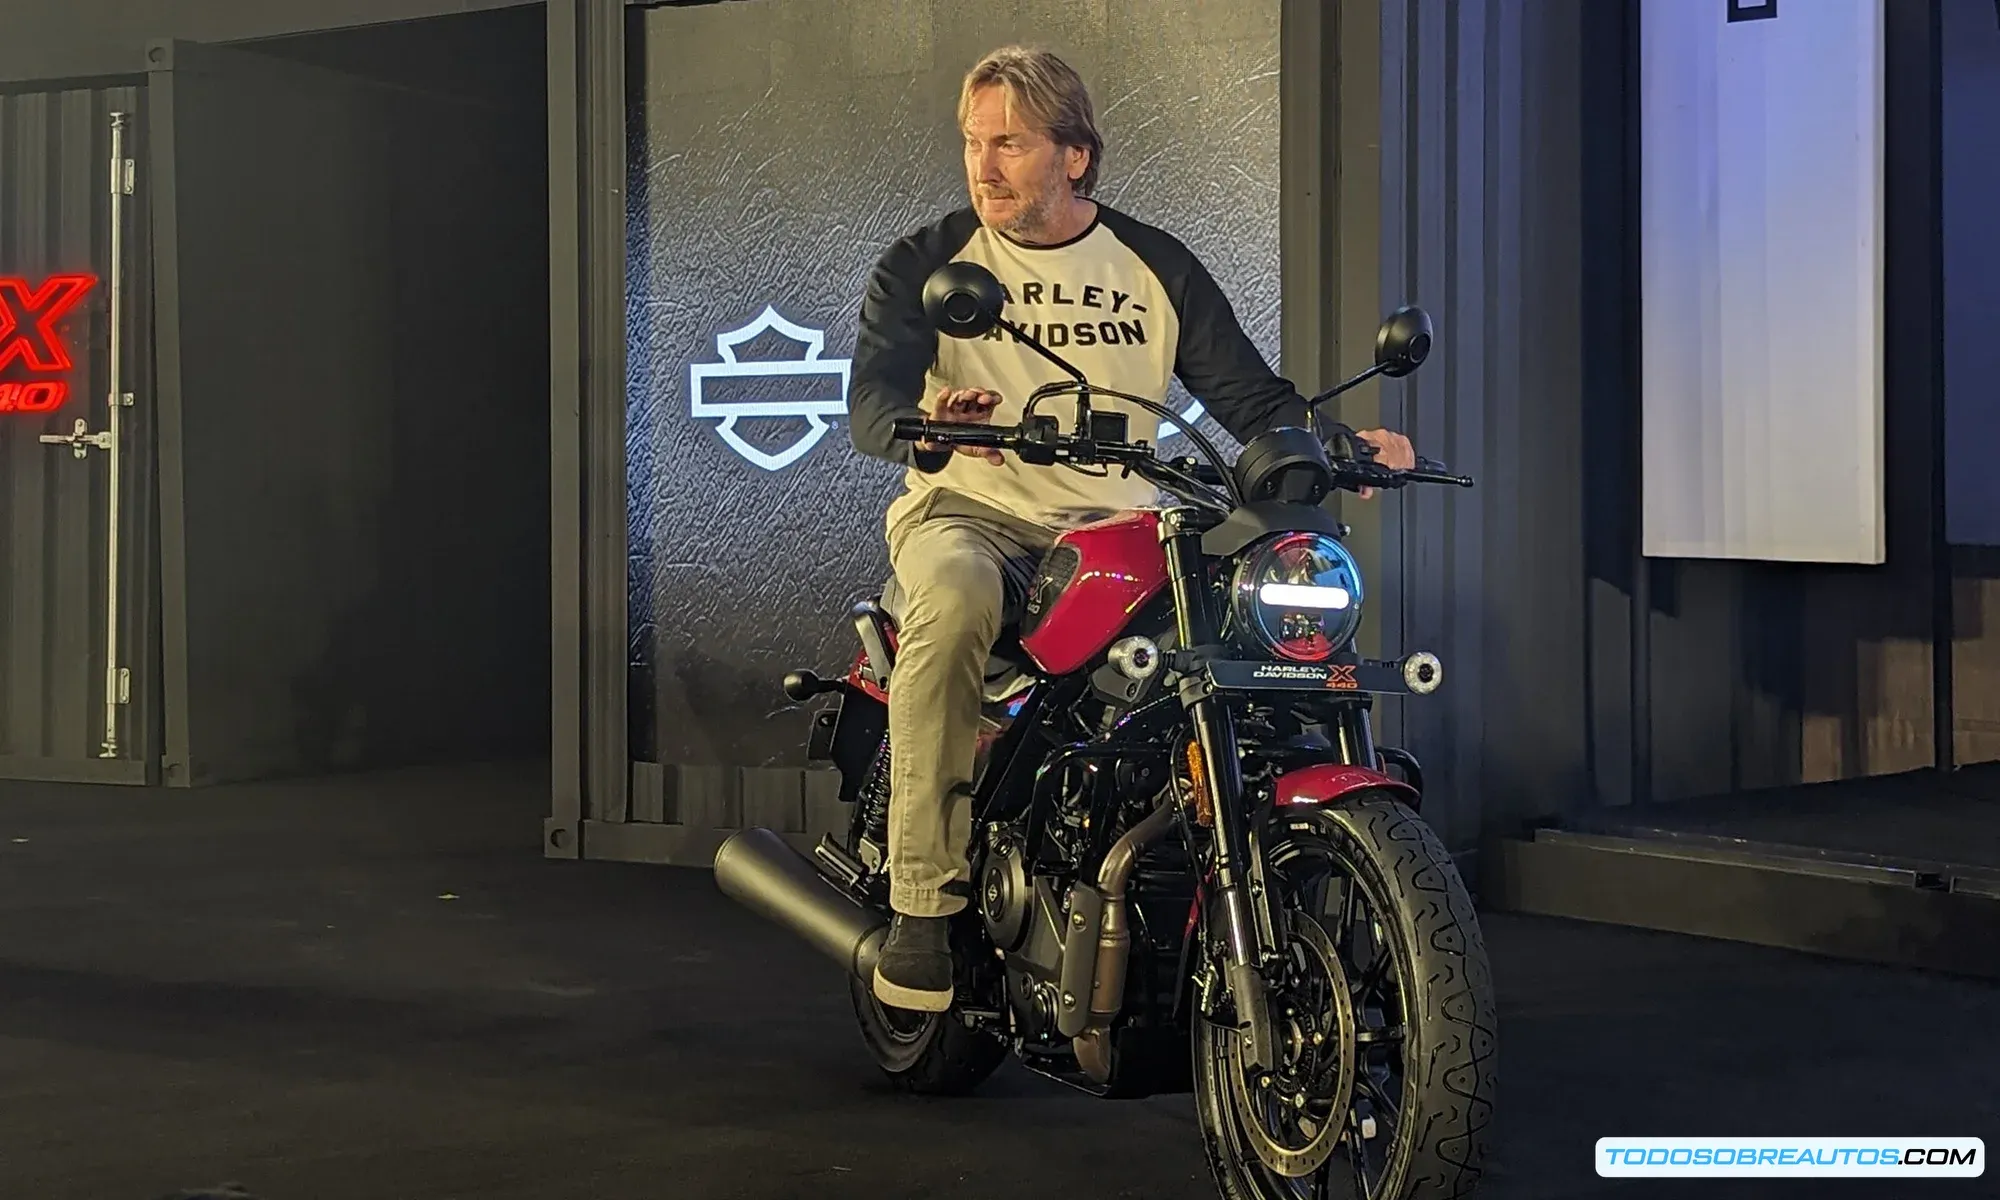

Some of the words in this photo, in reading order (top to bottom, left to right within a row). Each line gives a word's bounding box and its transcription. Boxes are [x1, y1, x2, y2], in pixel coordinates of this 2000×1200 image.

[1000, 282, 1148, 314] ARLEY-
[0, 275, 98, 371] X
[983, 319, 1147, 346] AVIDSON
[1253, 671, 1327, 679] DAVIDSON
[1326, 664, 1357, 682] X
